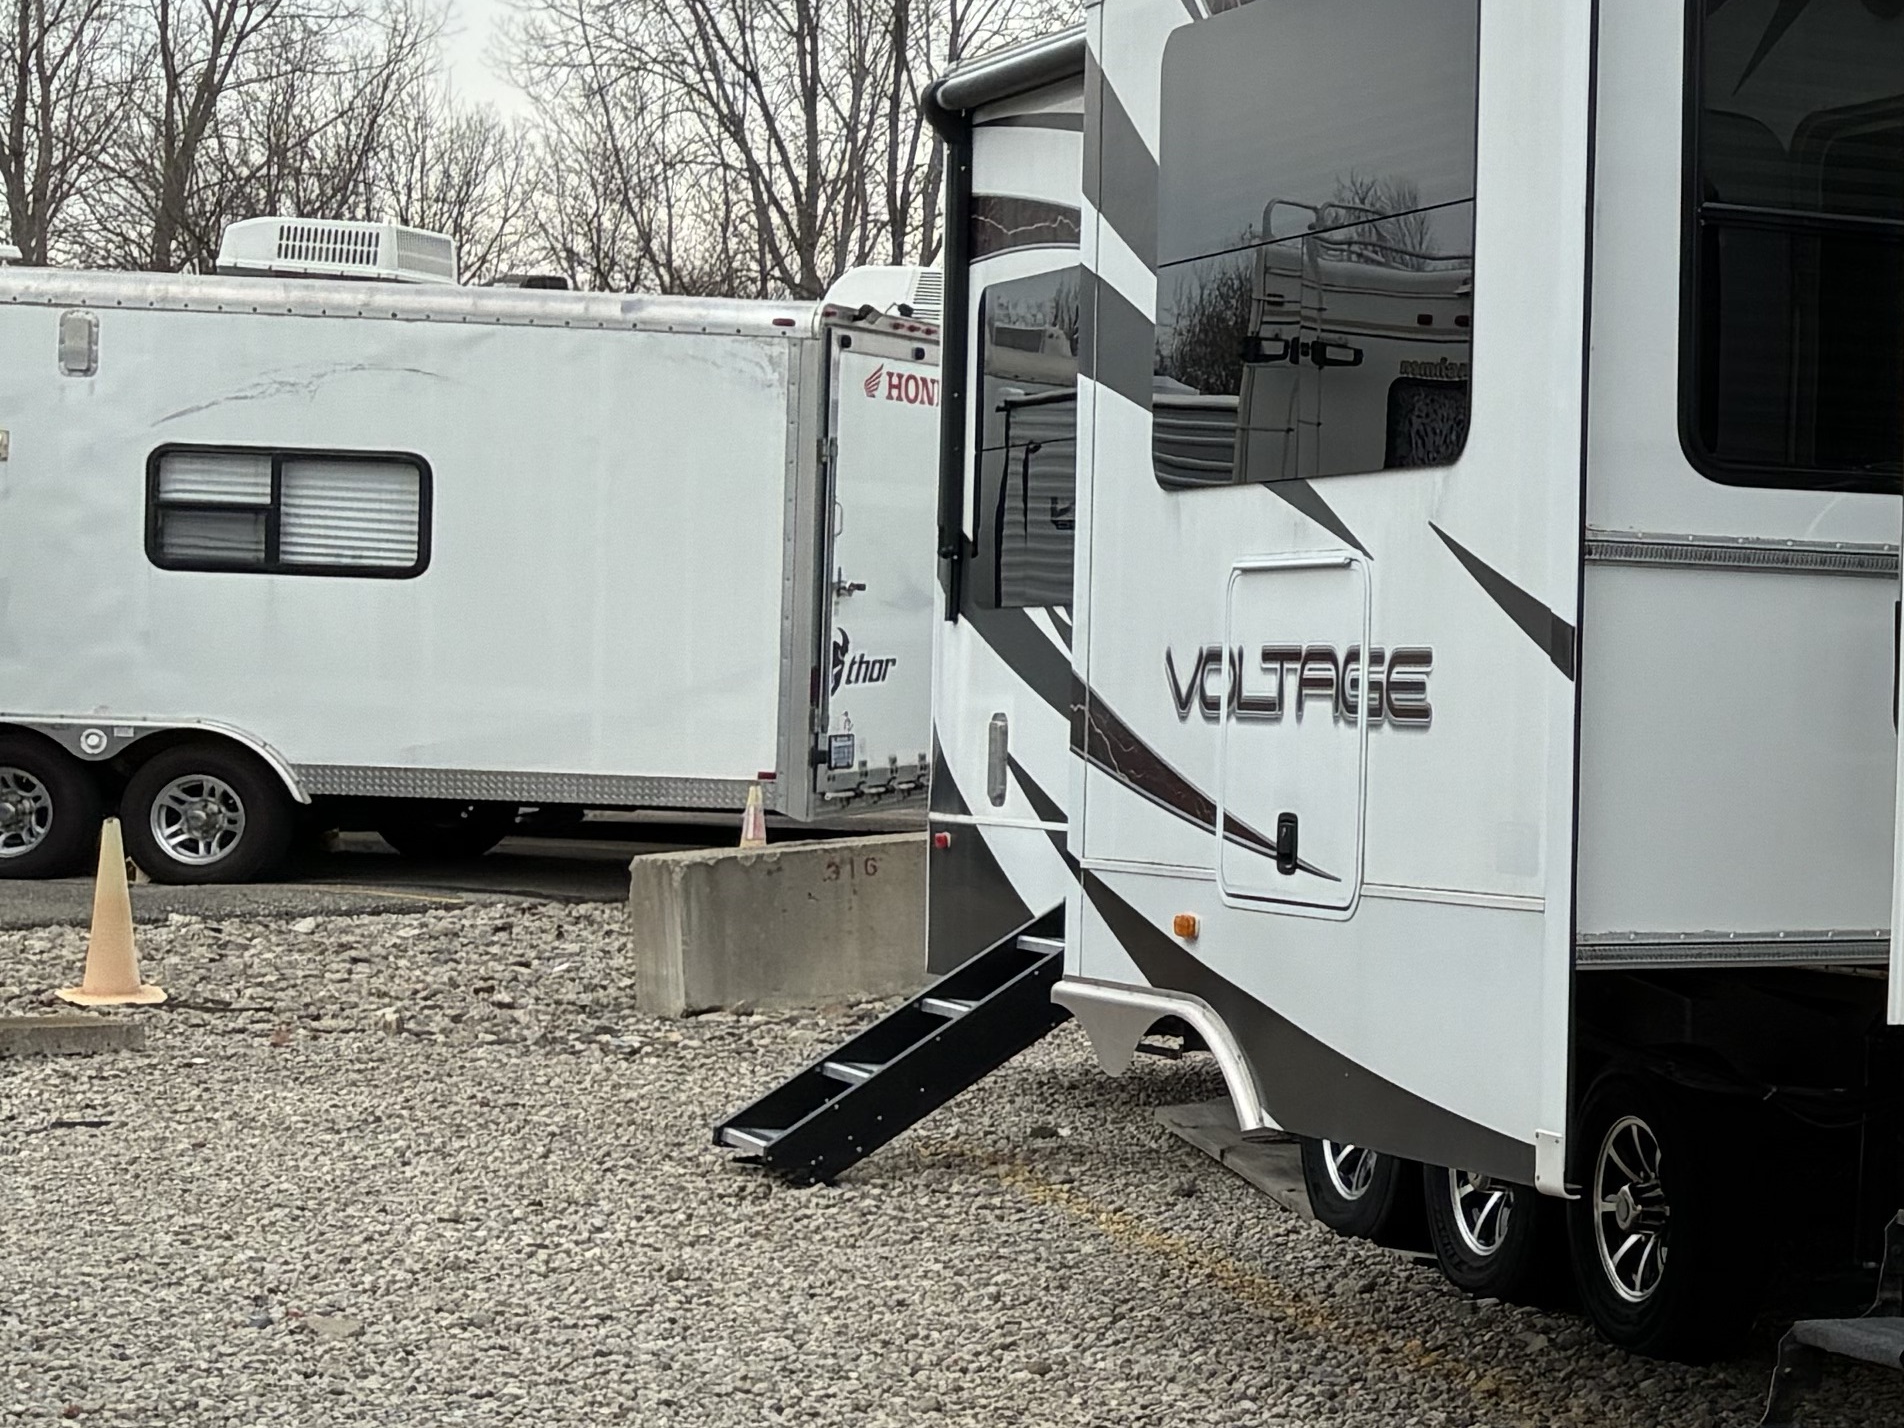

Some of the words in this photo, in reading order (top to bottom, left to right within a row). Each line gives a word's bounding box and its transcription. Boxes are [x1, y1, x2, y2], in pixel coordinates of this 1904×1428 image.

[886, 371, 940, 407] HON
[845, 653, 897, 686] thor
[1164, 645, 1434, 727] VOLTAGE
